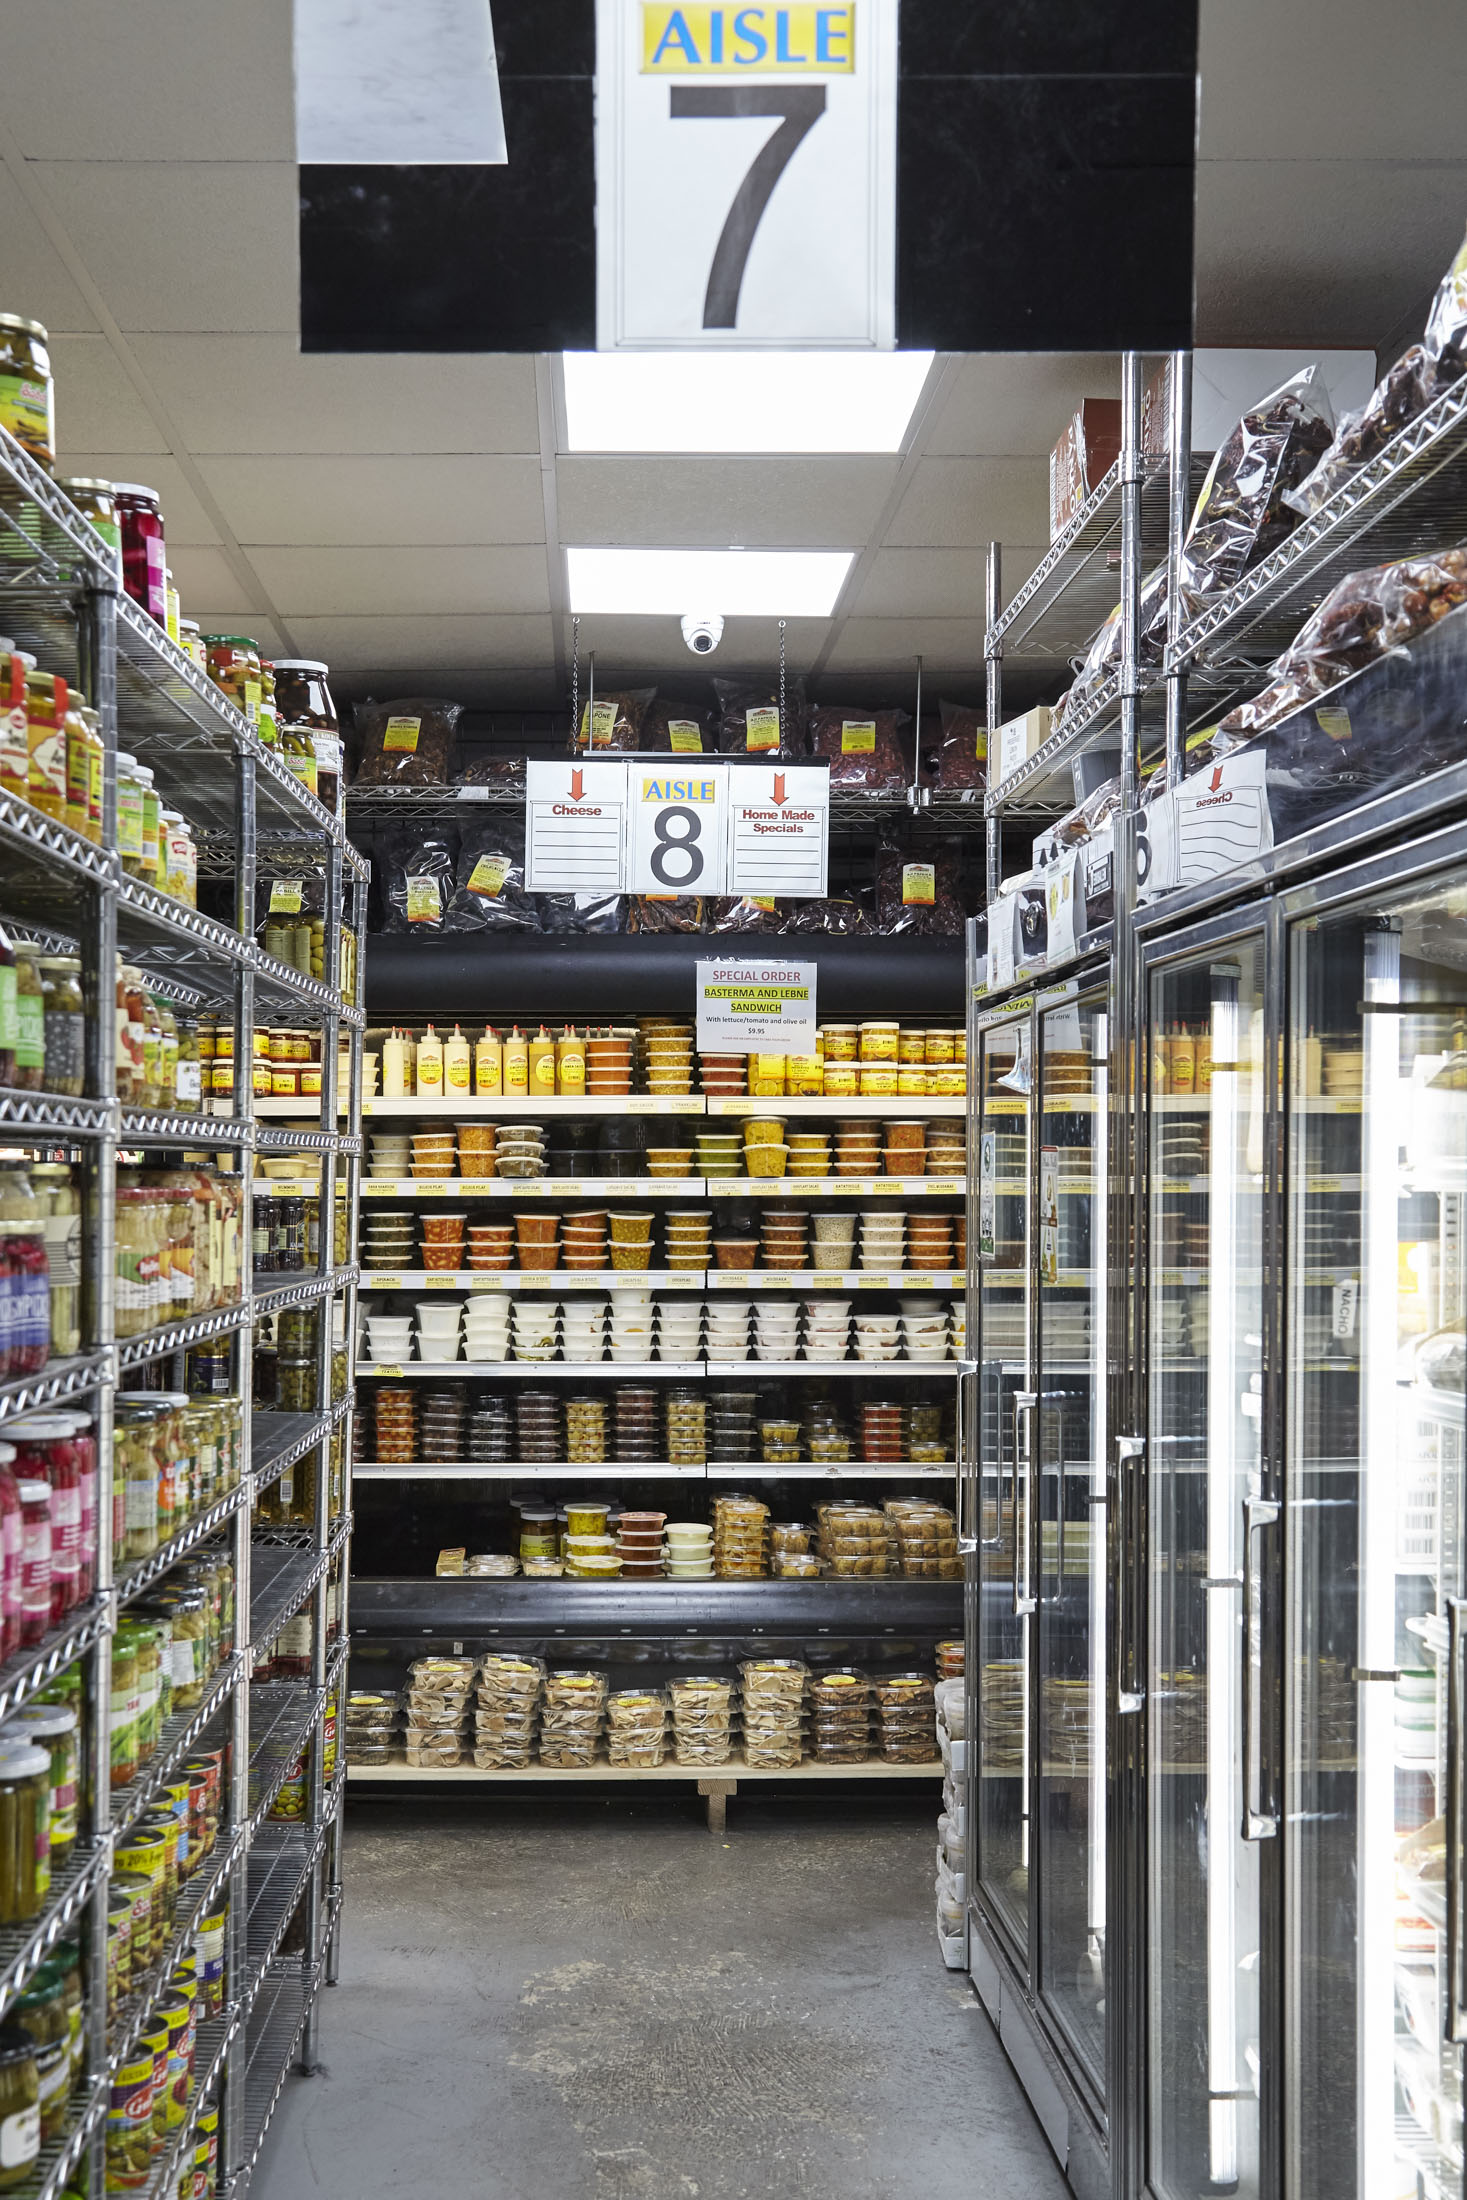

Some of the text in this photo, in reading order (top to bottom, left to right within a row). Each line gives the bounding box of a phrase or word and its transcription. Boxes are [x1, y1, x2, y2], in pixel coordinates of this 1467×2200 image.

[652, 8, 847, 64] AISLE
[670, 85, 826, 329] 7
[645, 781, 713, 801] AISLE
[552, 804, 602, 816] Cheese
[743, 809, 815, 820] Home Made
[753, 823, 804, 834] Specials
[650, 806, 704, 888] 8
[712, 970, 801, 981] SPECIAL ORDER
[704, 988, 809, 998] BASTERMA AND LEBNE
[730, 1002, 782, 1012] SANDWICH
[722, 1016, 769, 1025] lettuce/tomato
[770, 1017, 781, 1025] and
[748, 1027, 765, 1035] $9.95
[1338, 1288, 1352, 1335] NACHO
